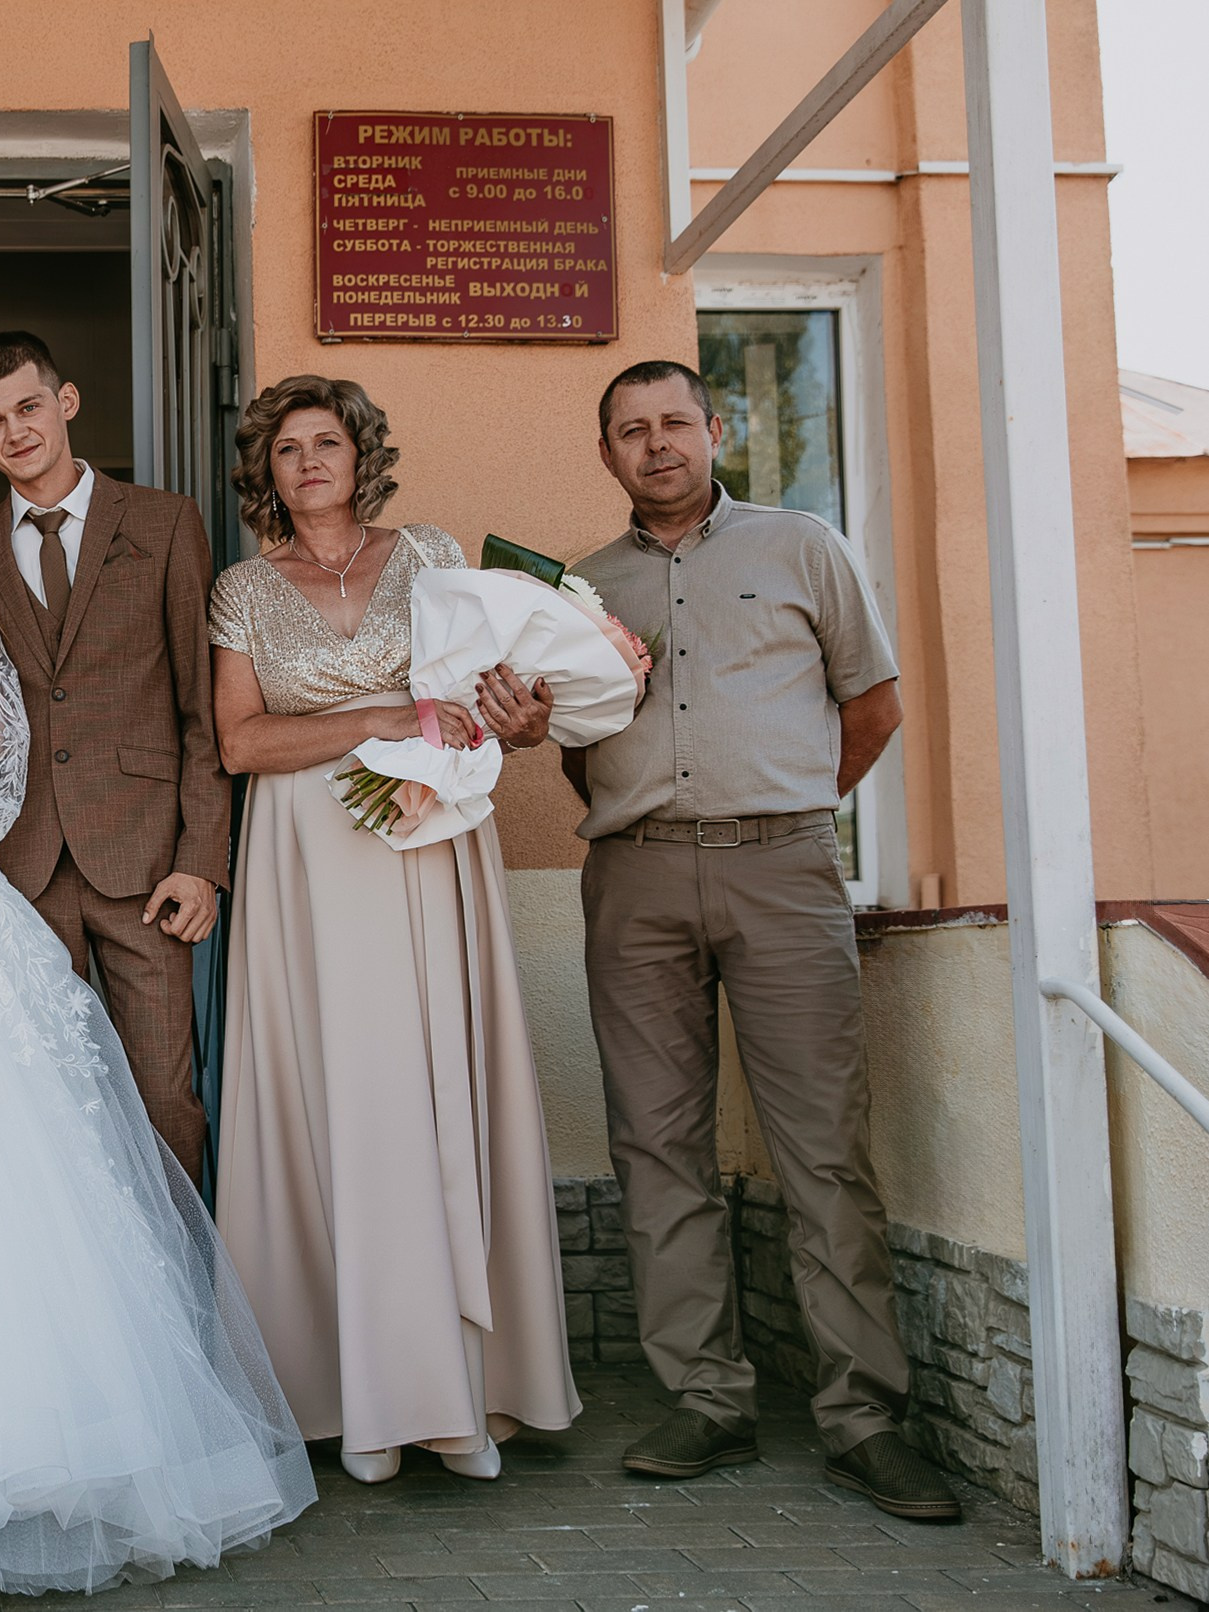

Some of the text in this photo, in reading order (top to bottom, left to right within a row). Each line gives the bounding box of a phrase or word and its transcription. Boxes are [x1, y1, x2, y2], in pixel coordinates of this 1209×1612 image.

[358, 125, 573, 147] РЕЖИМ РАБОТЫ:
[333, 156, 422, 169] ВТОРНИК
[333, 174, 396, 190] СРЕДА
[456, 167, 587, 182] ПРИЕМНЫЕ ДНИ
[449, 188, 459, 198] с
[466, 185, 507, 198] 9.00
[513, 187, 536, 201] до
[333, 193, 426, 209] ПЯТНИЦА
[333, 219, 408, 232] ЧЕТВЕРГ
[428, 219, 548, 234] НЕПРИЕМНЫЙ
[554, 222, 599, 235] ДЕНЬ
[333, 239, 411, 252] СУББОТА
[427, 240, 575, 254] ТОРЖЕСТВЕННАЯ
[426, 257, 608, 272] РЕГИСТРАЦИЯ БРАКА
[333, 274, 455, 287] ВОСКРЕСЕНЬЕ
[333, 292, 461, 305] ПОНЕДЕЛЬНИК
[349, 313, 583, 330] ПЕРЕРЫВ с 12.30 до 13.30
